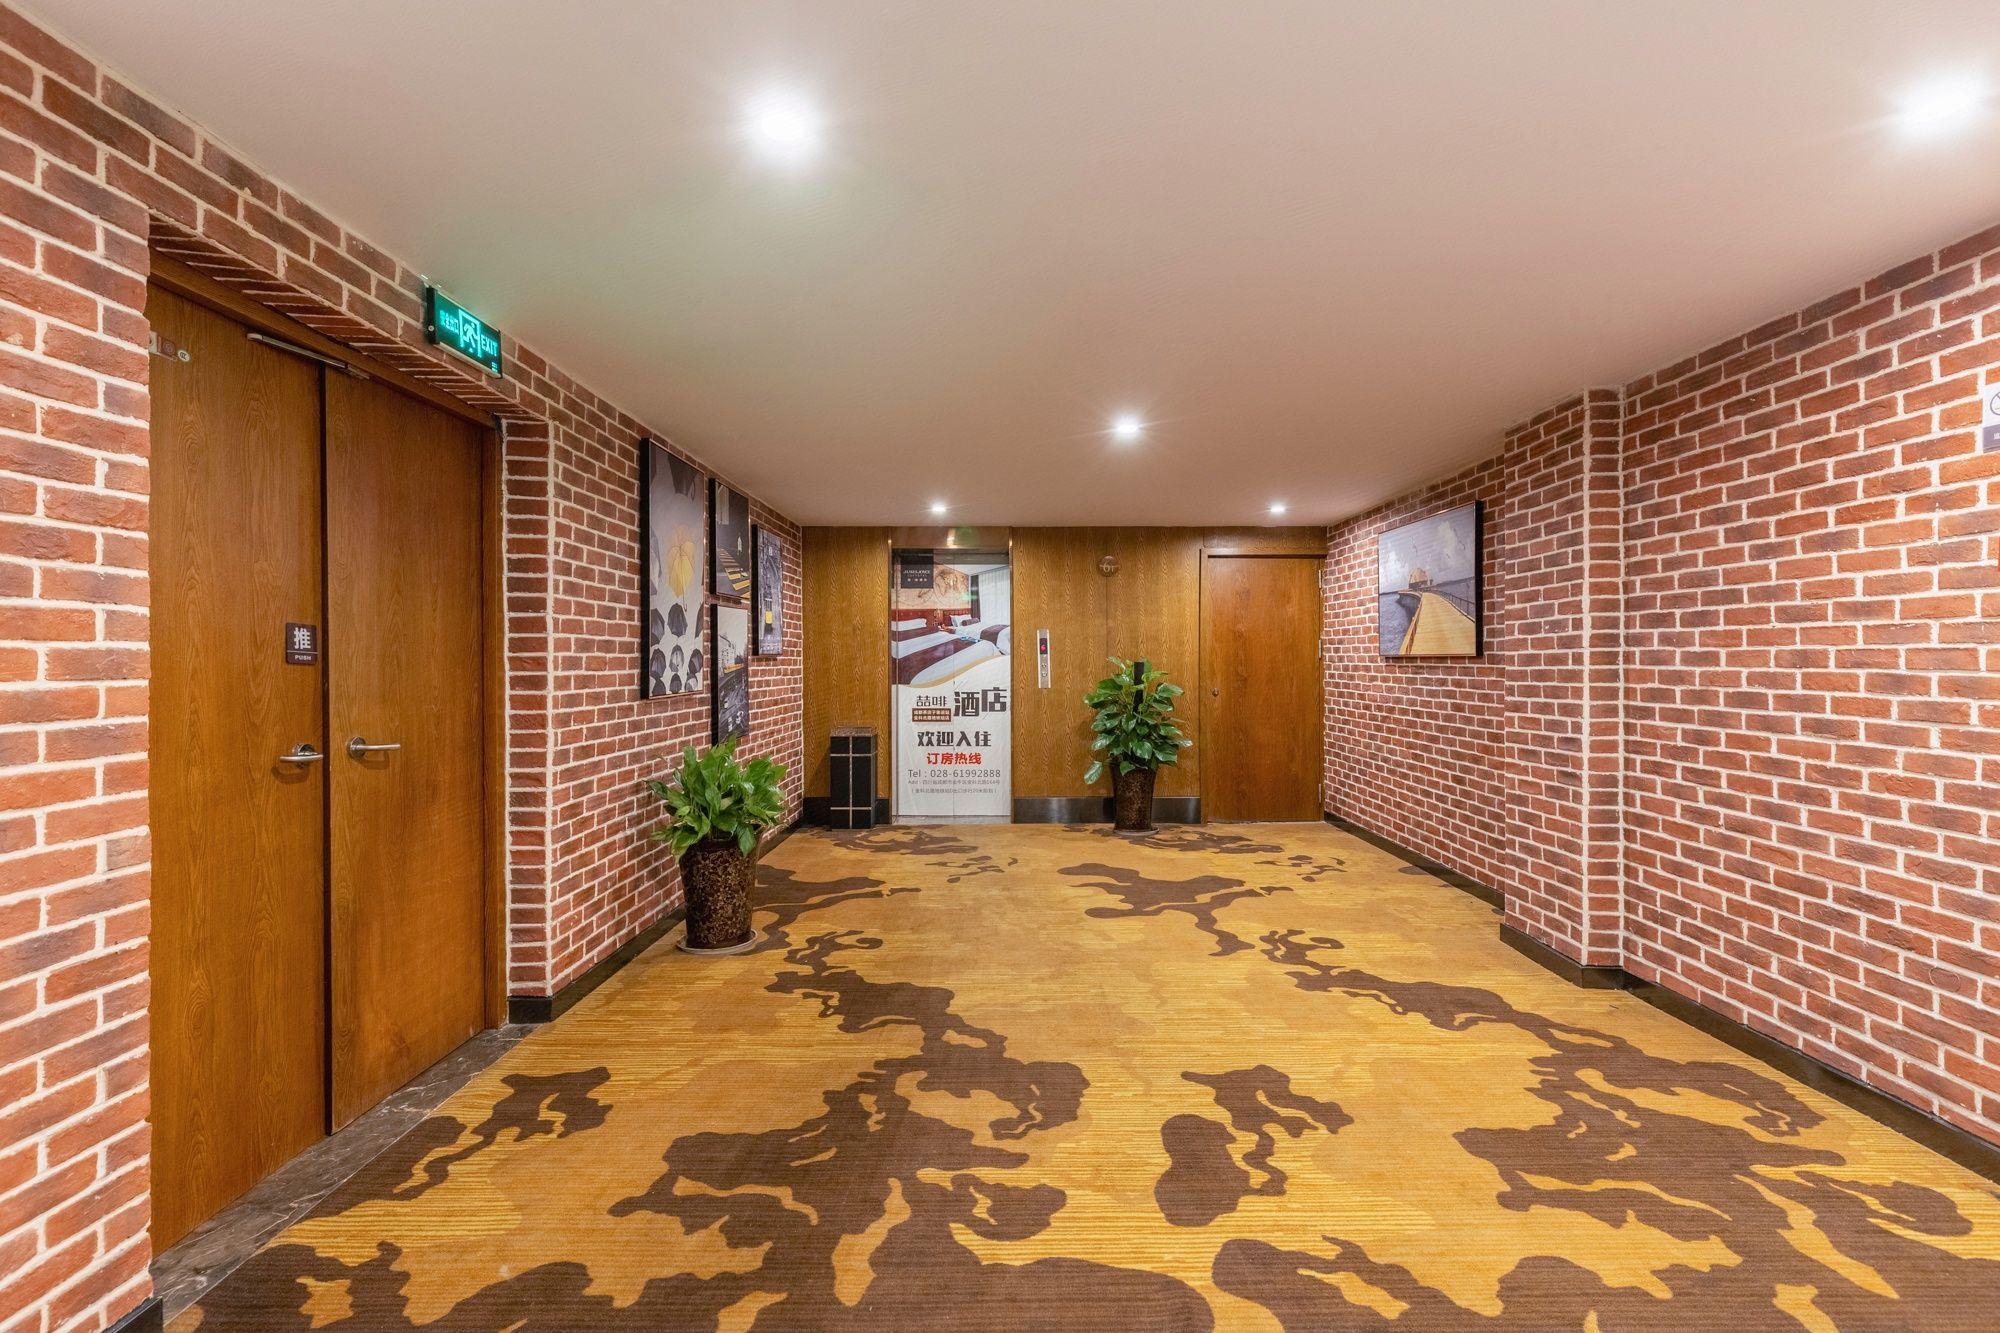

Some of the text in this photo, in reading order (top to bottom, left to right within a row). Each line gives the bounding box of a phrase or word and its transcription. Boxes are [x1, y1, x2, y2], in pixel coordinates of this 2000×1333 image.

[481, 334, 498, 356] EXIT
[294, 628, 311, 649] 推
[916, 695, 948, 707] 喆啡
[953, 687, 1007, 716] 酒店
[917, 731, 992, 747] 欢迎入住
[926, 752, 982, 765] 订房热线
